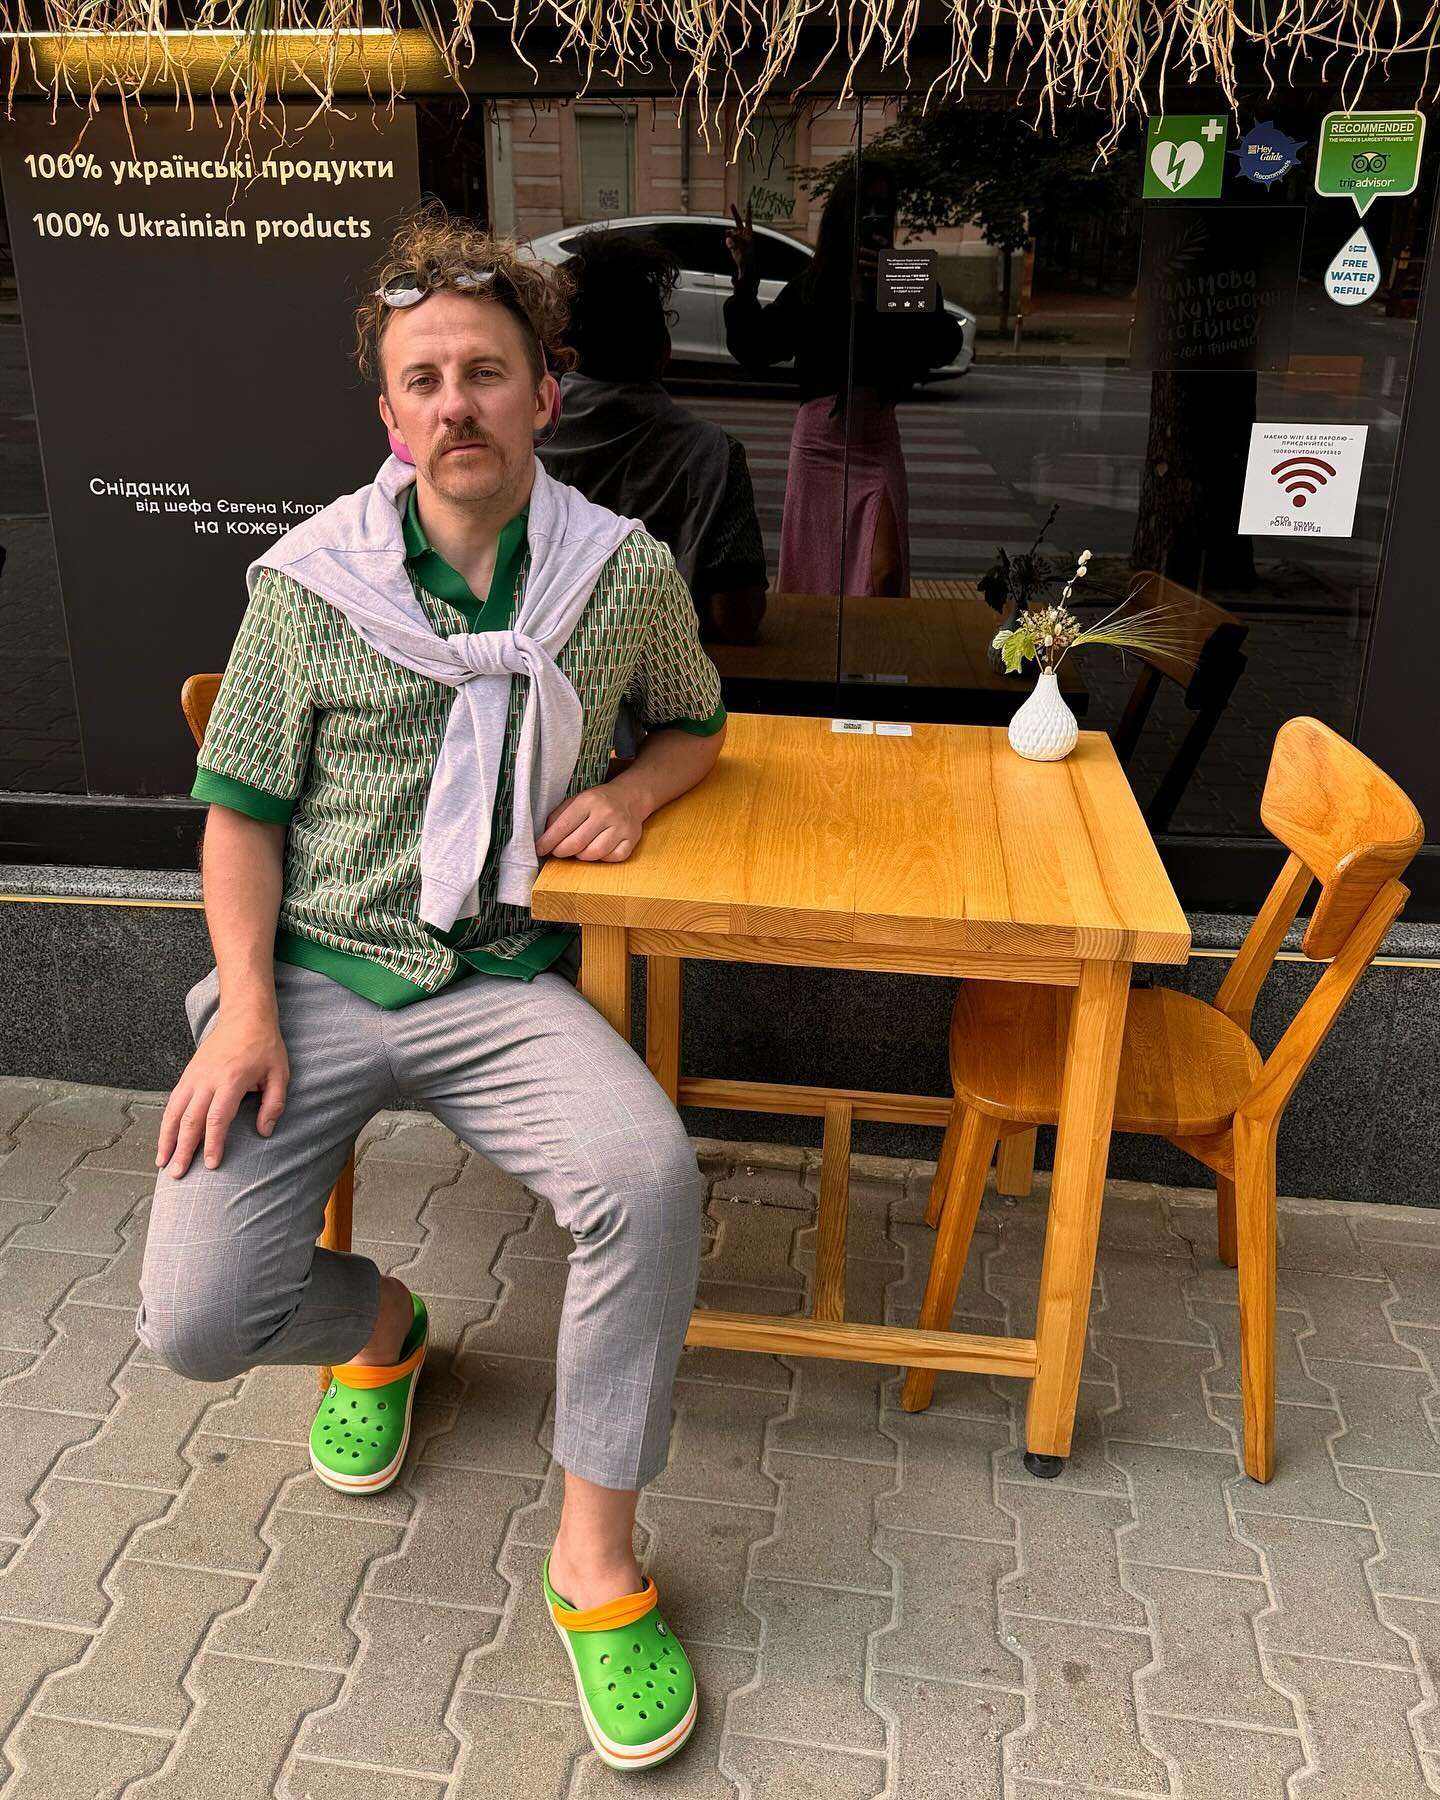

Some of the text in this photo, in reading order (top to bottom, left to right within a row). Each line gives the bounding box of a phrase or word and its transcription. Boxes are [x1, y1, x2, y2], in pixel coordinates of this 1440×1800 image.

[1331, 123, 1415, 133] RECOMMENDED
[1257, 145, 1273, 155] Hey
[1260, 152, 1283, 161] Guide
[24, 153, 394, 186] 100% українські продукти
[1254, 160, 1292, 180] Recommends
[1340, 177, 1392, 189] tripadvisor
[32, 212, 371, 244] 100% Ukrainian products
[1342, 260, 1368, 268] FREE
[1331, 272, 1376, 282] WATER
[1333, 286, 1368, 295] REFILL
[89, 478, 190, 497] Сніданки
[136, 499, 160, 514] від
[164, 499, 212, 515] шефа
[217, 500, 277, 514] Євгена
[194, 521, 290, 535] на кожен
